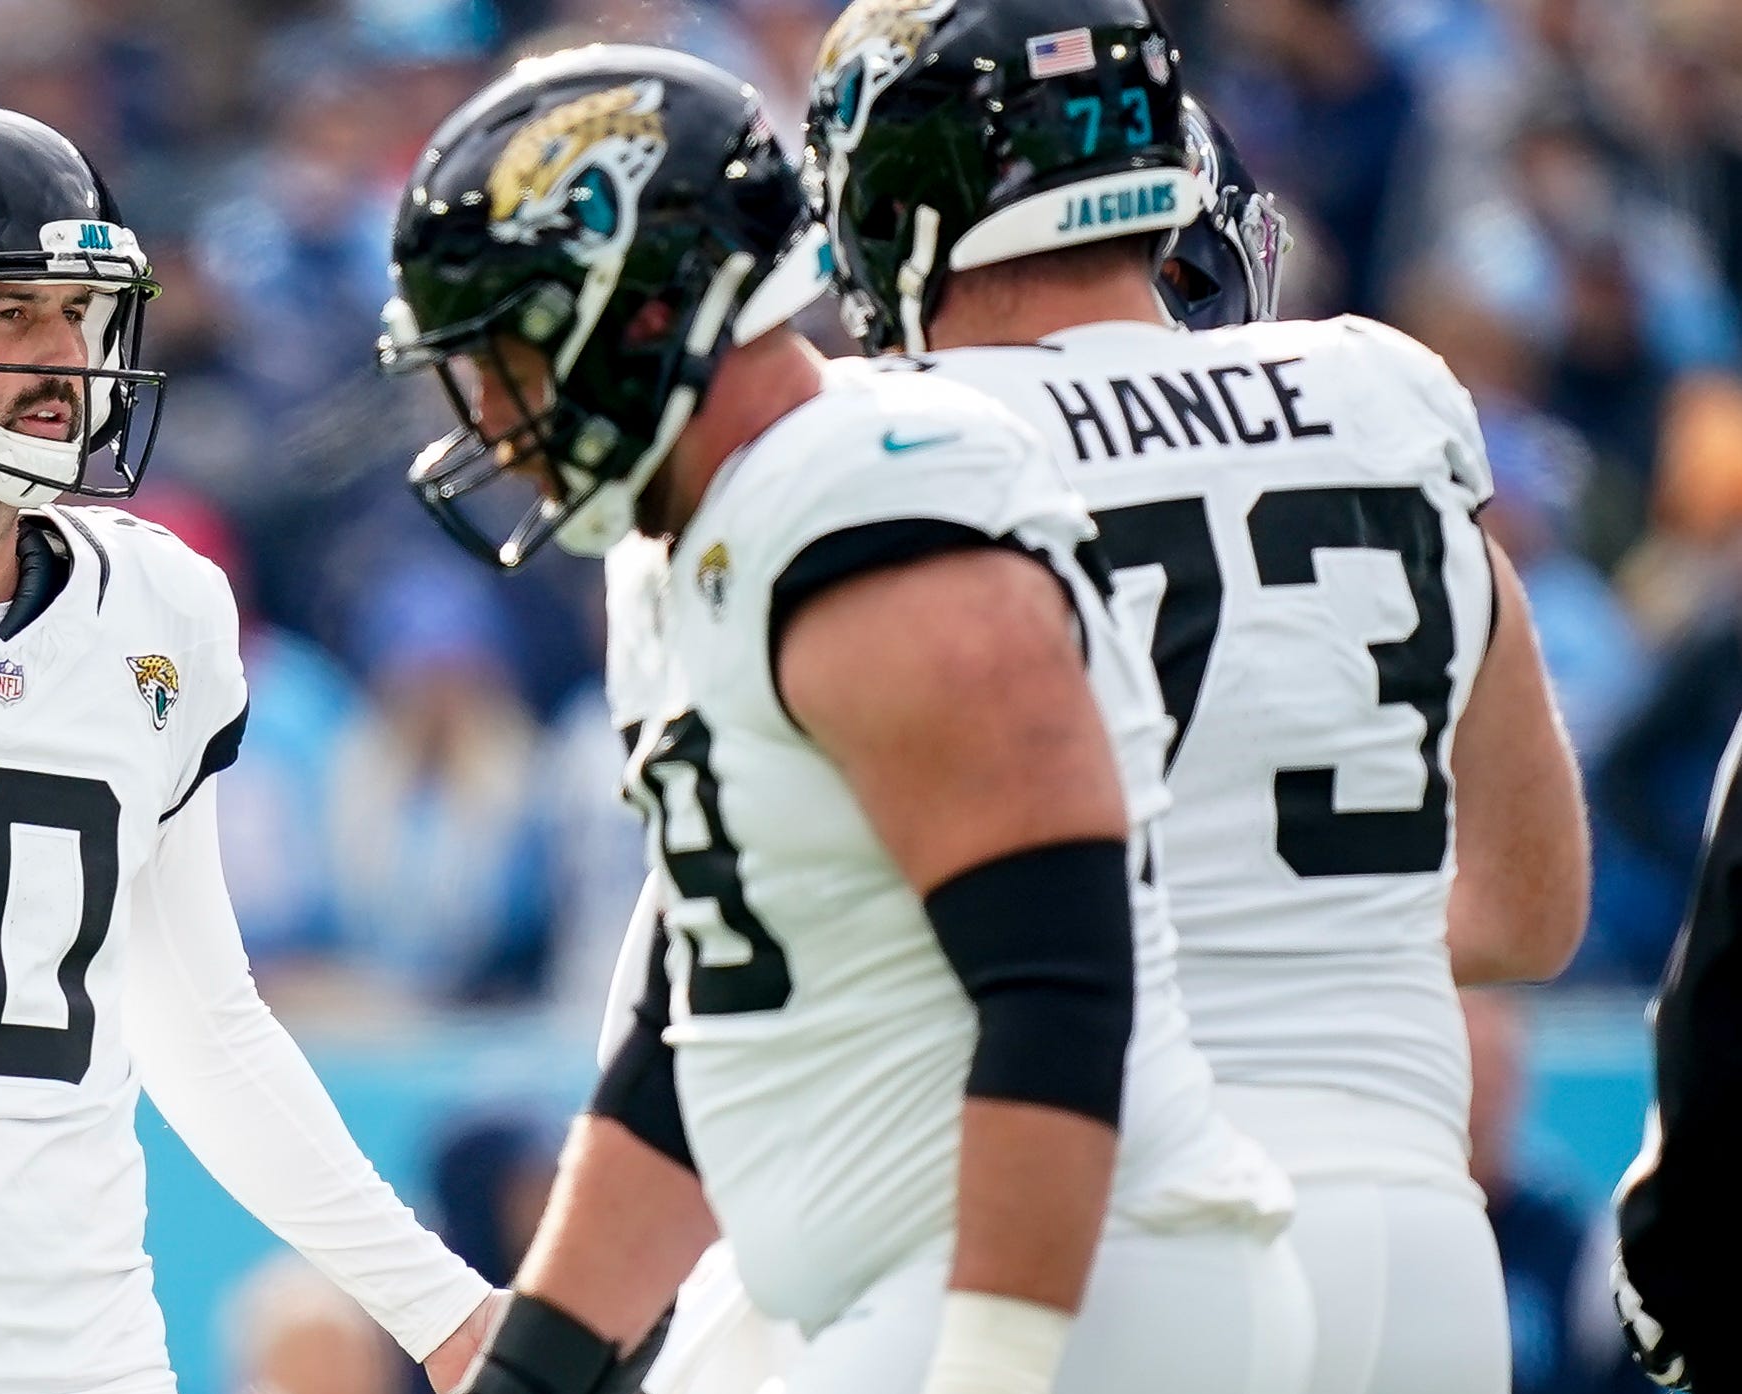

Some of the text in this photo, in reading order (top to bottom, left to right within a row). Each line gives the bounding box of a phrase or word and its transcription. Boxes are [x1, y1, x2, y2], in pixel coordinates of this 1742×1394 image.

[1065, 86, 1152, 155] 73
[78, 223, 113, 249] JAX
[1058, 181, 1177, 231] JAGUARS
[1043, 356, 1331, 460] HANCE
[1074, 486, 1456, 879] 73
